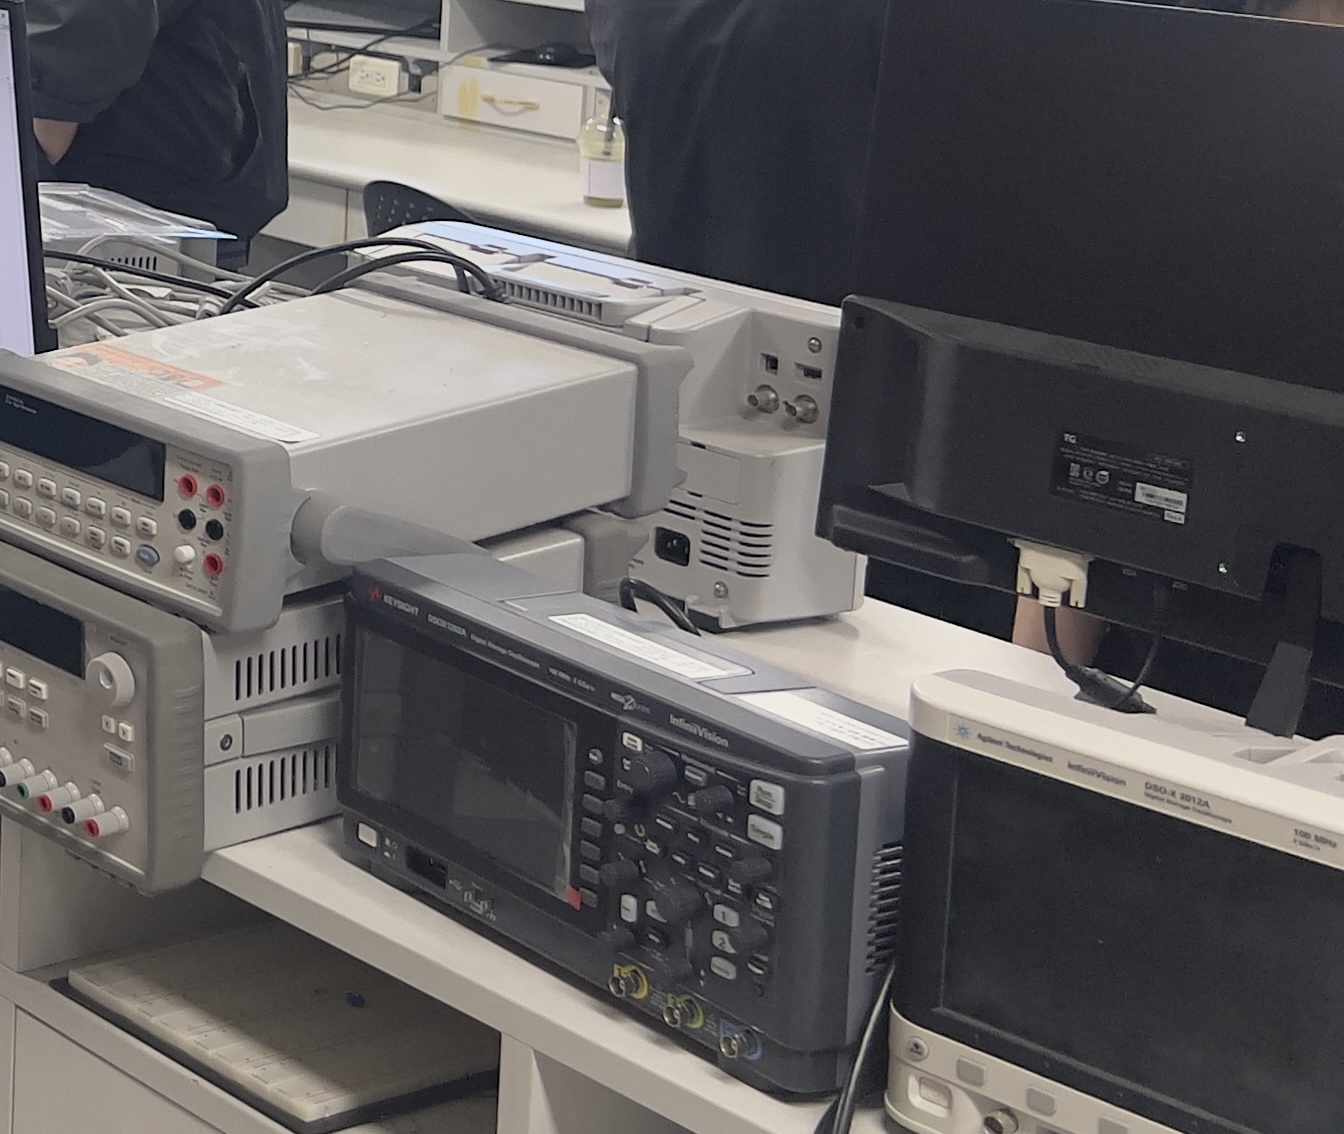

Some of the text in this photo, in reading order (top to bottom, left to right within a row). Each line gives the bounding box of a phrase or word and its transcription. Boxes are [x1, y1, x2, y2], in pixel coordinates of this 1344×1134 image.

[1064, 433, 1077, 444] TG
[384, 594, 419, 616] KEYSIGHT
[1145, 781, 1210, 809] DSO-X 2012A
